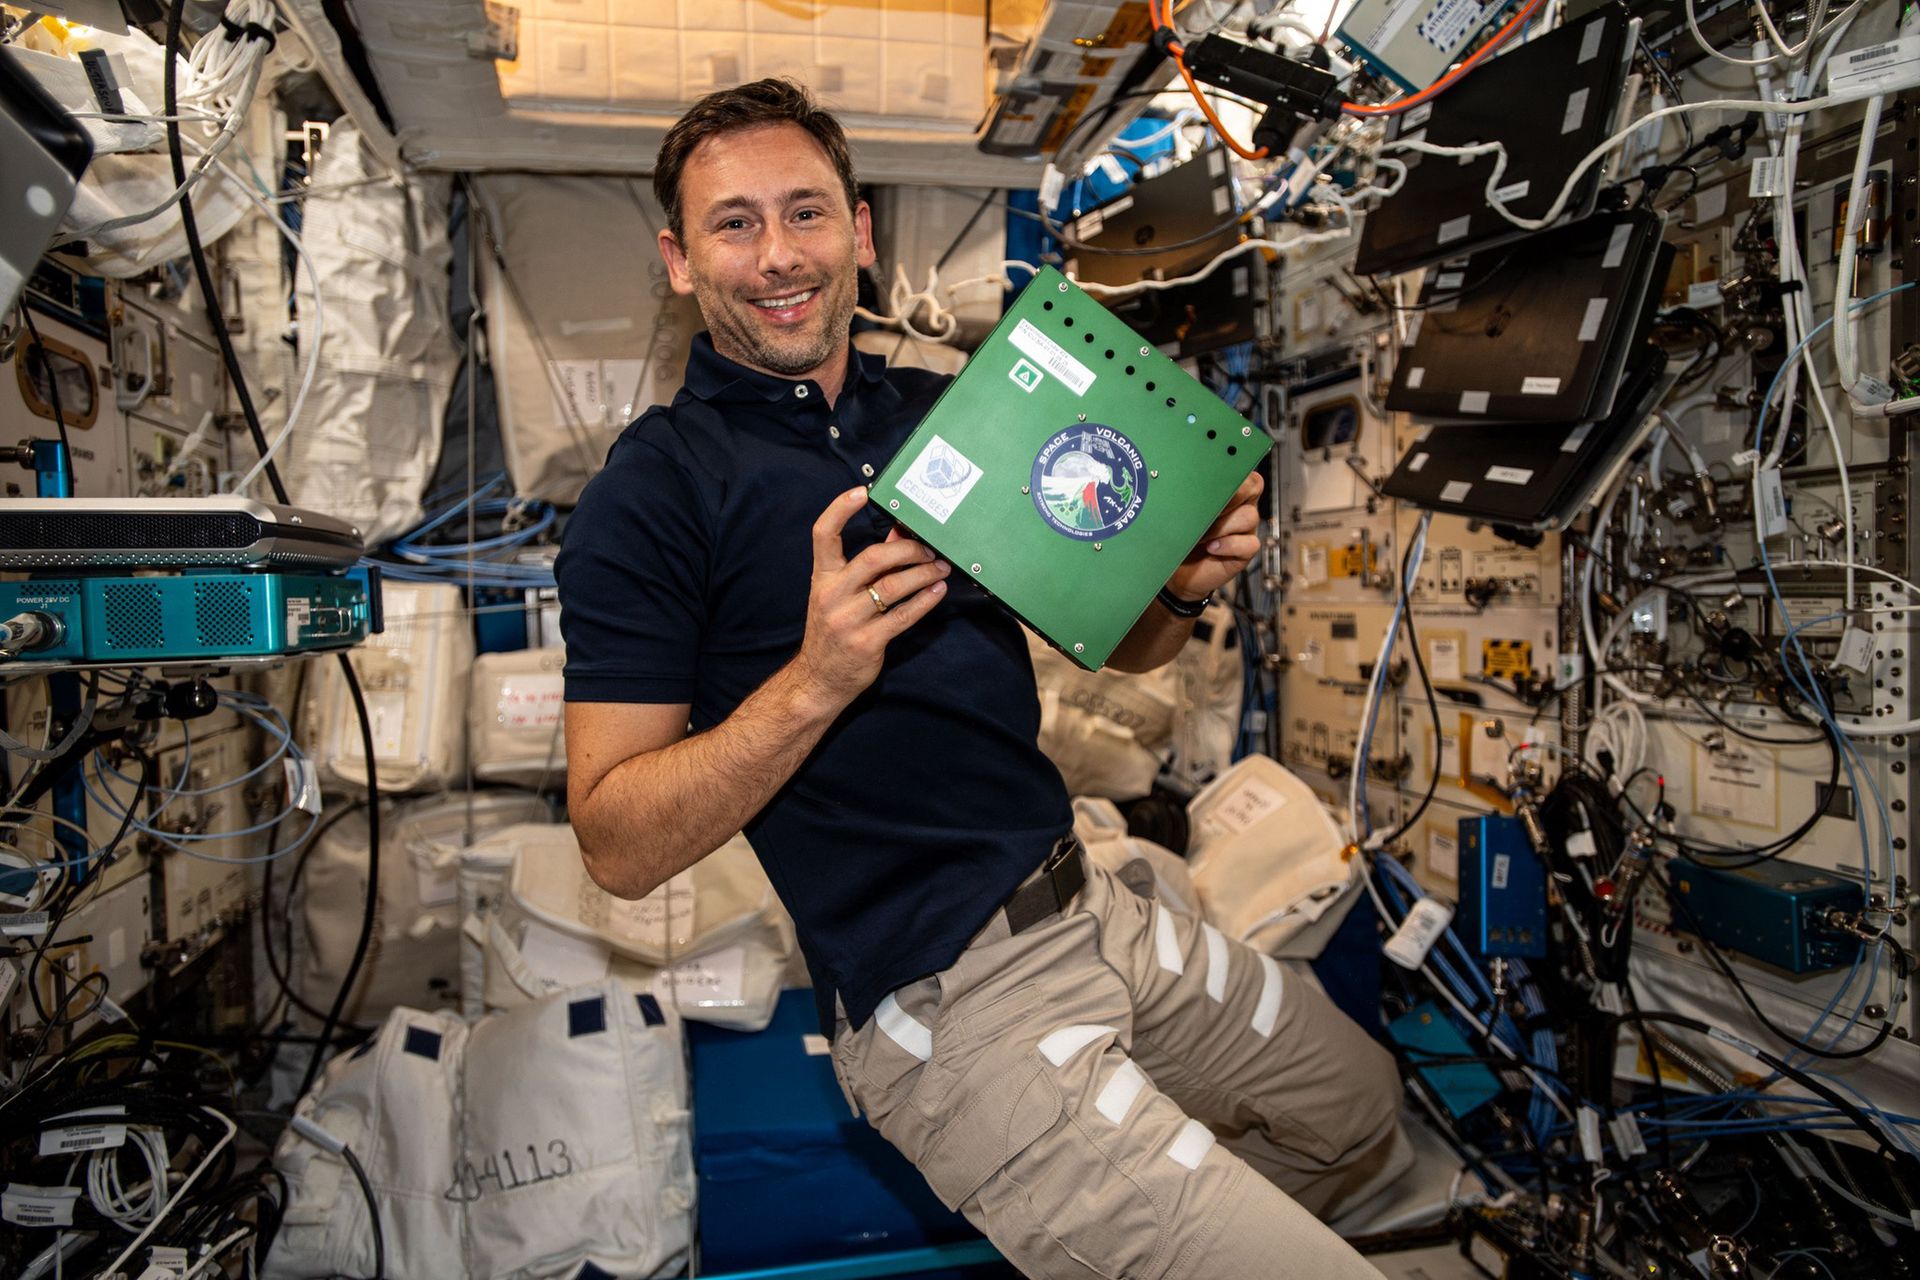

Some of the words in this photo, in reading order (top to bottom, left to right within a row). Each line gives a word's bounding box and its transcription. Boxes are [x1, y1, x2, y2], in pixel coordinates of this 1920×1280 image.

[1039, 432, 1069, 465] SPACE
[1096, 427, 1143, 470] VOLCANIC
[900, 475, 950, 518] ICECUBES
[1114, 495, 1142, 530] ALGAE
[1051, 516, 1093, 537] TECHNOLOGIES
[16, 596, 43, 604] POWER
